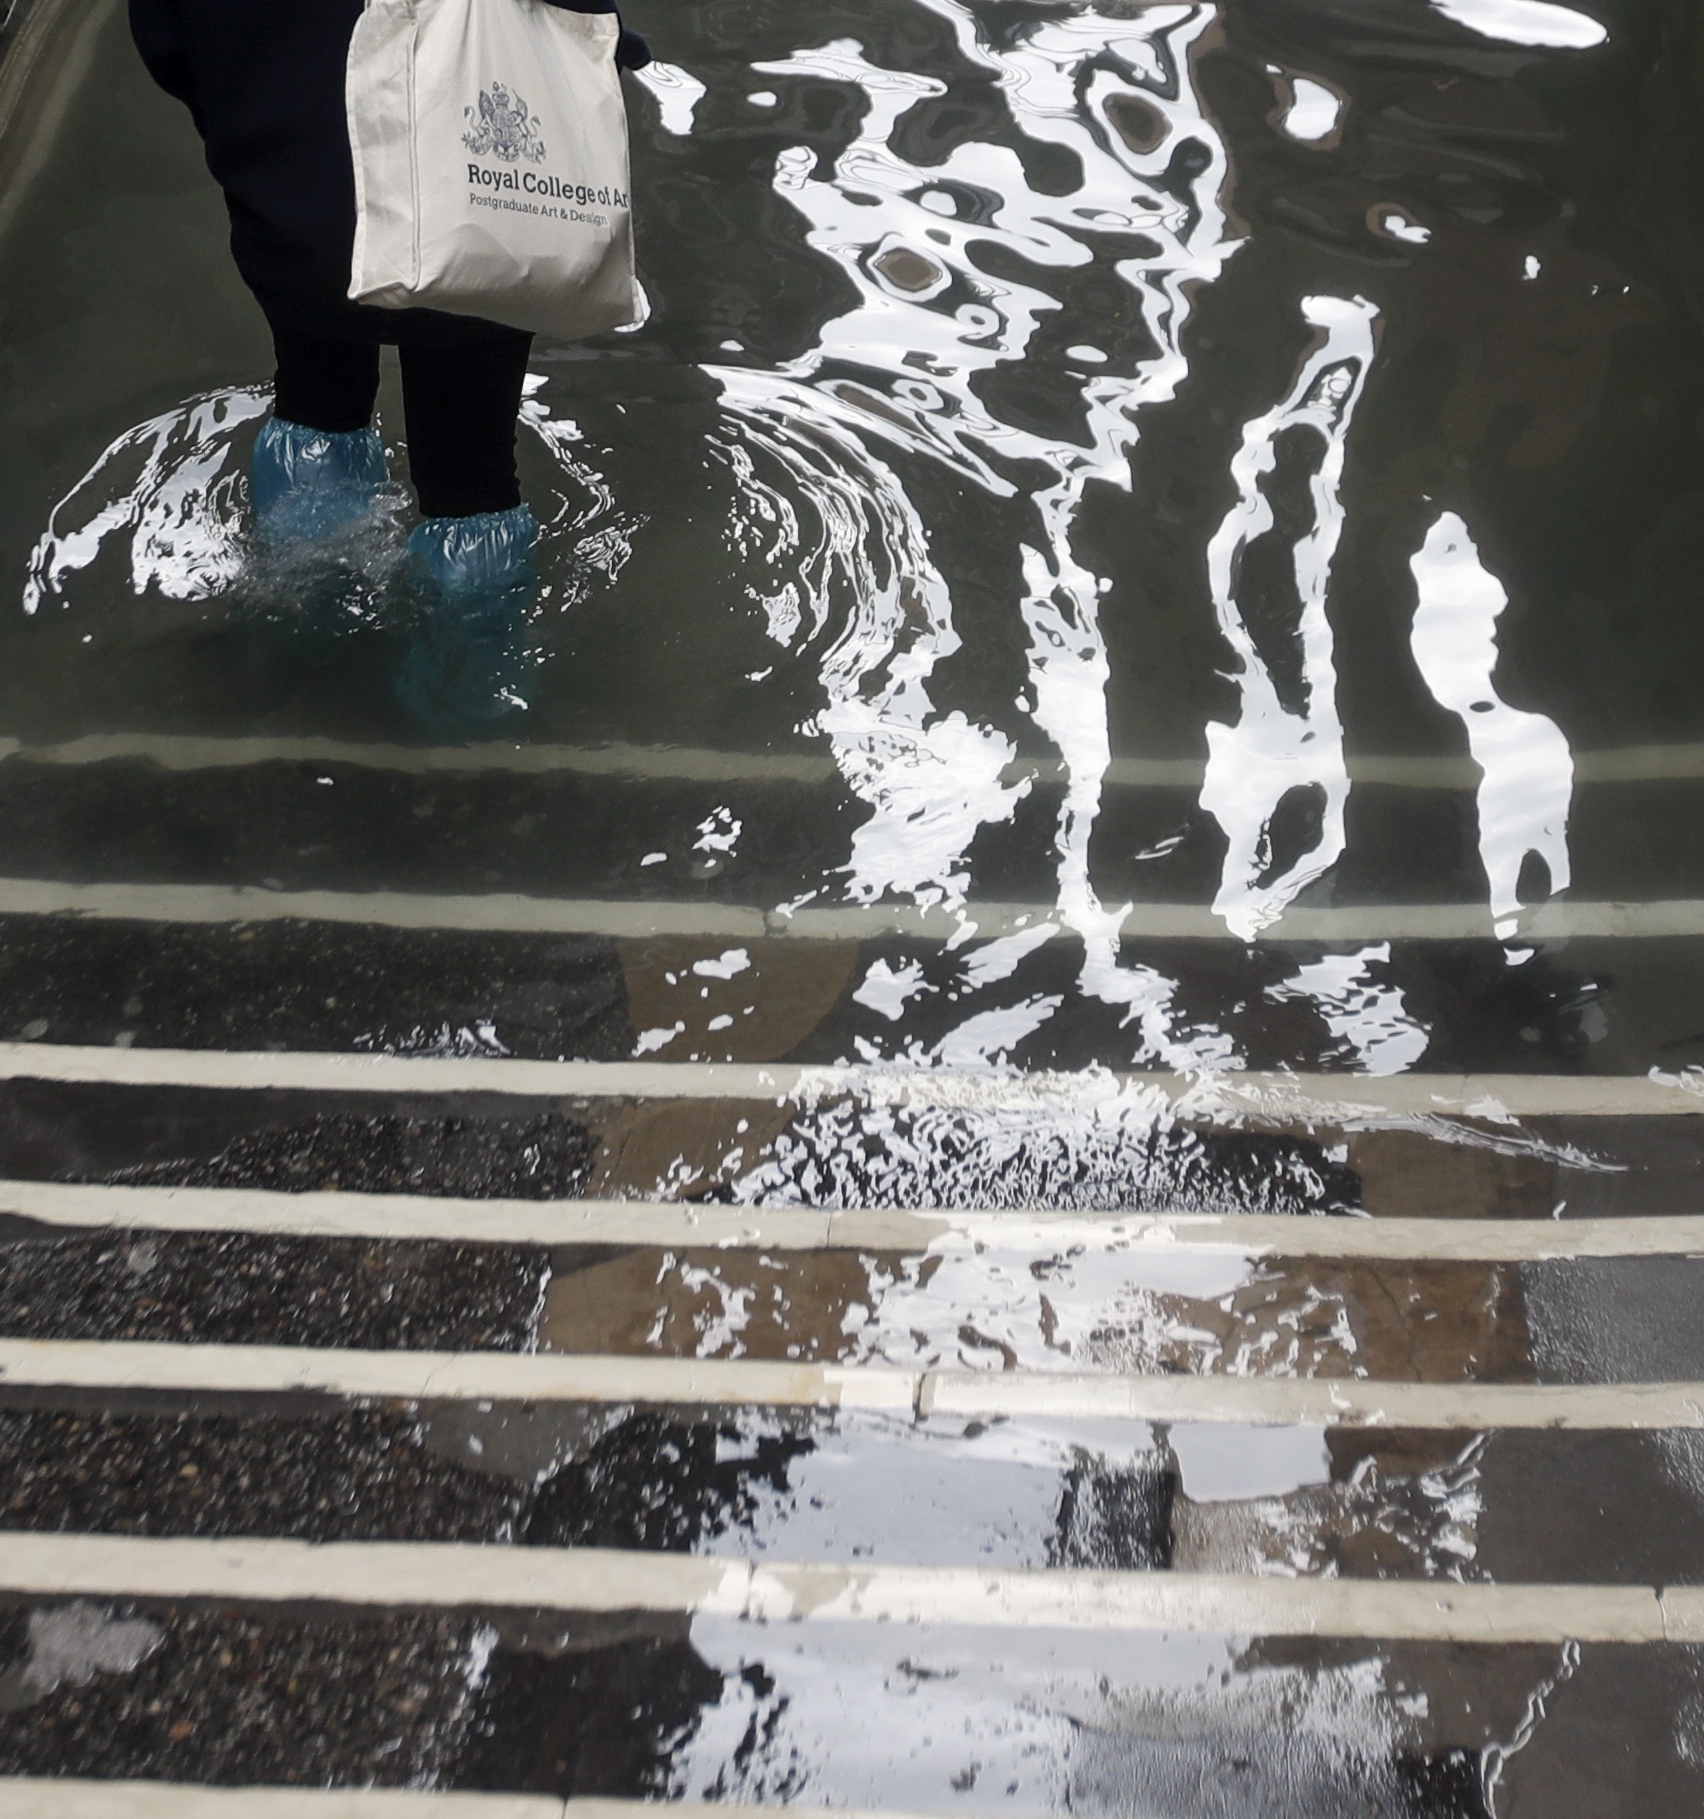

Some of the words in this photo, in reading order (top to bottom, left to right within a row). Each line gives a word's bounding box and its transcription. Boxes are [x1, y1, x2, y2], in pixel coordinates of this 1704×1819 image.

[467, 163, 520, 191] Royal
[523, 172, 596, 206] College
[597, 186, 612, 207] of
[613, 188, 629, 208] Ar
[469, 192, 539, 215] Postgraduate
[540, 205, 558, 218] Art
[560, 208, 568, 220] &
[570, 209, 608, 227] Design
